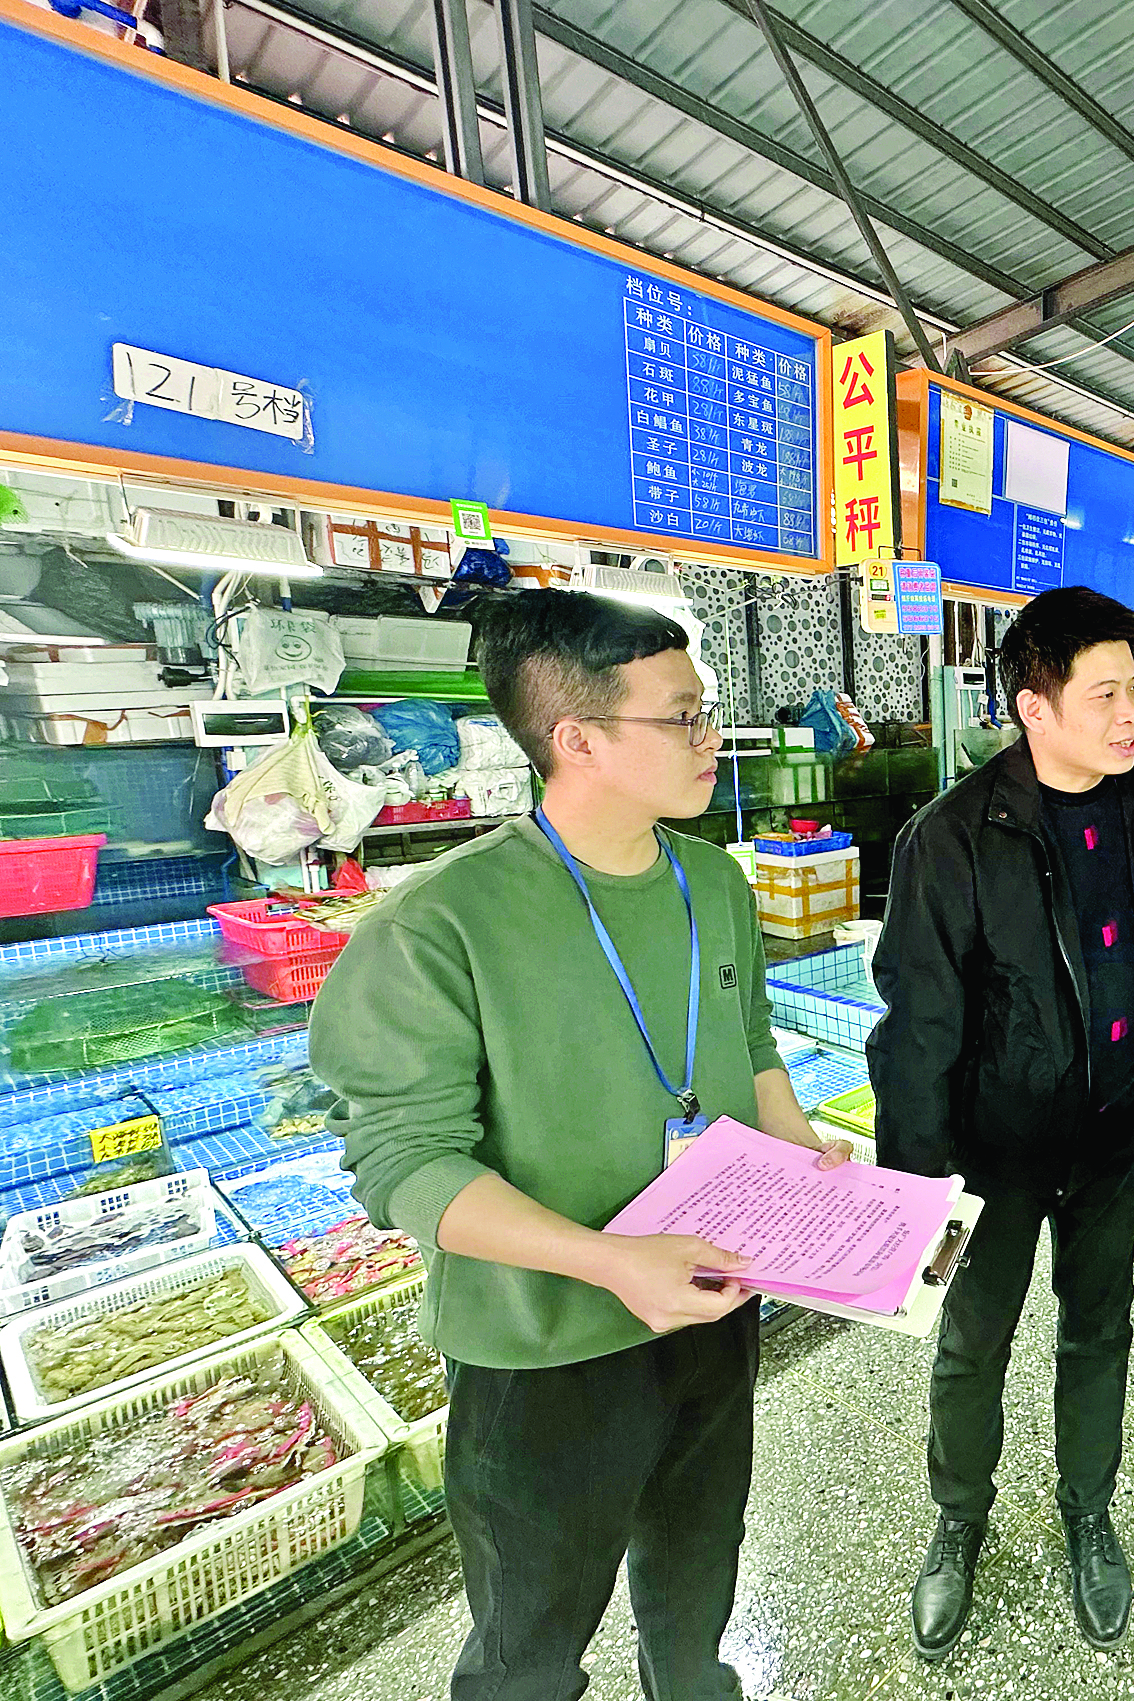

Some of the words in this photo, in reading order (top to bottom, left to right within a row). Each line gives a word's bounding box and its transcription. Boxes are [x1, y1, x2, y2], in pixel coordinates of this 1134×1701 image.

[635, 306, 674, 335] 种类
[687, 325, 722, 352] 价格
[735, 342, 767, 367] 种类
[778, 357, 807, 382] 价格
[643, 337, 672, 359] 扇贝
[732, 365, 773, 391] 泥猛鱼
[642, 361, 675, 382] 石斑
[733, 389, 774, 414] 多宝鱼
[643, 387, 675, 407] 花甲
[733, 412, 774, 435] 东星斑
[636, 410, 684, 434] 白鲳鱼
[741, 437, 768, 456] 青龙
[839, 351, 881, 552] 公平秤
[646, 436, 678, 455] 圣子
[741, 459, 768, 477] 波龙
[646, 461, 678, 481] 鲍鱼
[648, 485, 680, 503] 带子
[649, 510, 680, 527] 沙白
[872, 565, 883, 577] 21
[722, 968, 734, 982] M
